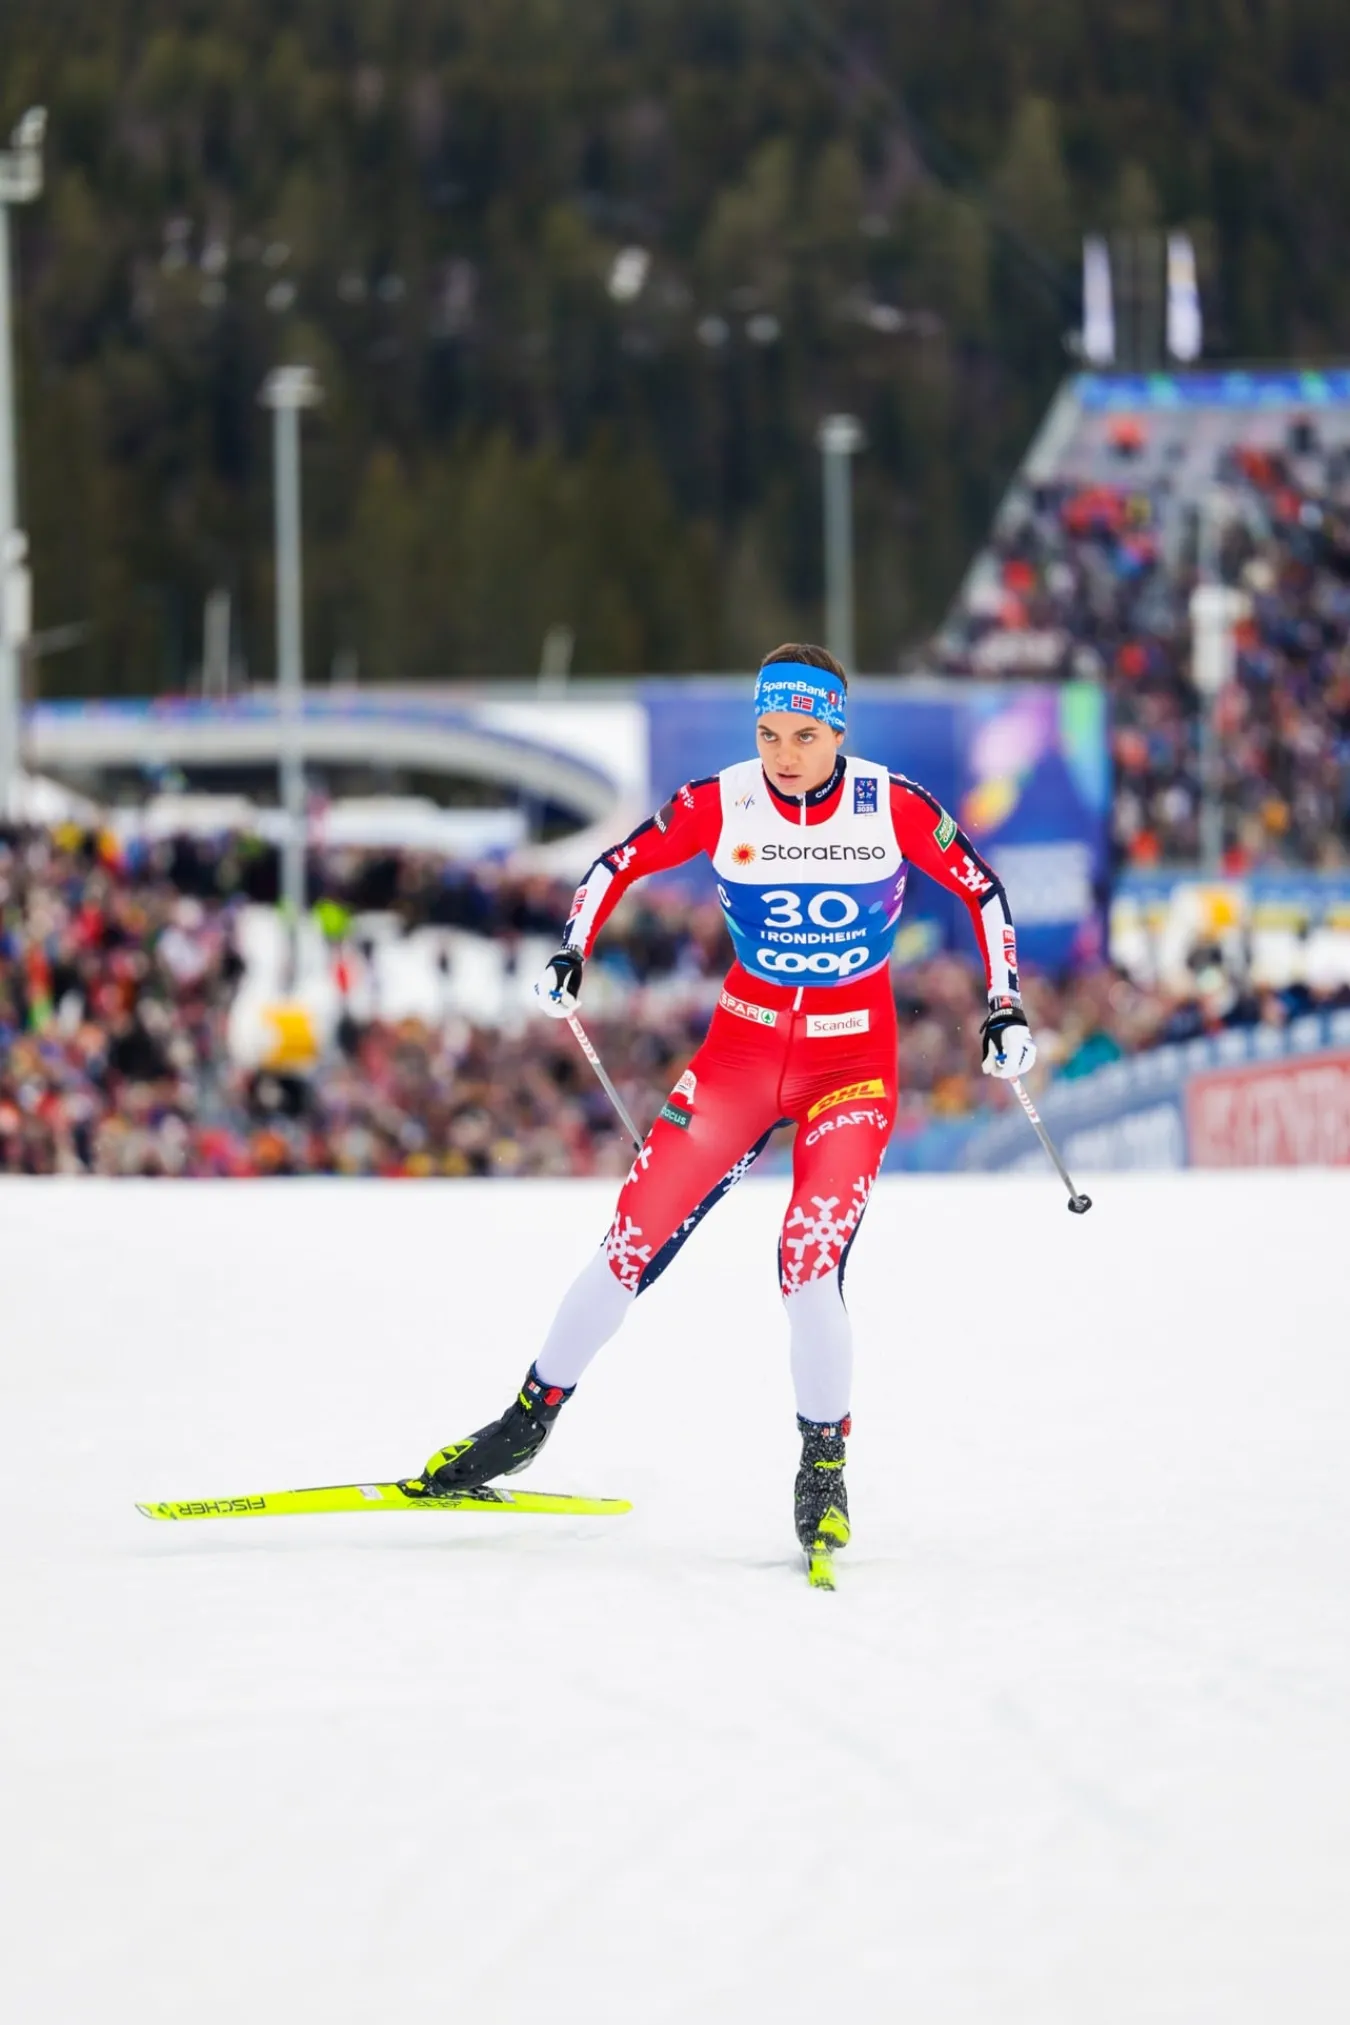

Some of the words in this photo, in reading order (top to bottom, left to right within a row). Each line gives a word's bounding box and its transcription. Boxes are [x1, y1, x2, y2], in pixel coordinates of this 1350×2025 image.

[762, 681, 828, 699] SpareBank
[761, 844, 886, 861] StoraEnso
[760, 890, 860, 928] 30
[756, 946, 869, 976] coop
[721, 993, 759, 1019] SPAR
[814, 1017, 863, 1031] Scandic
[818, 1084, 874, 1110] DHL
[806, 1111, 874, 1146] CRAFT
[177, 1497, 265, 1515] FISCHER
